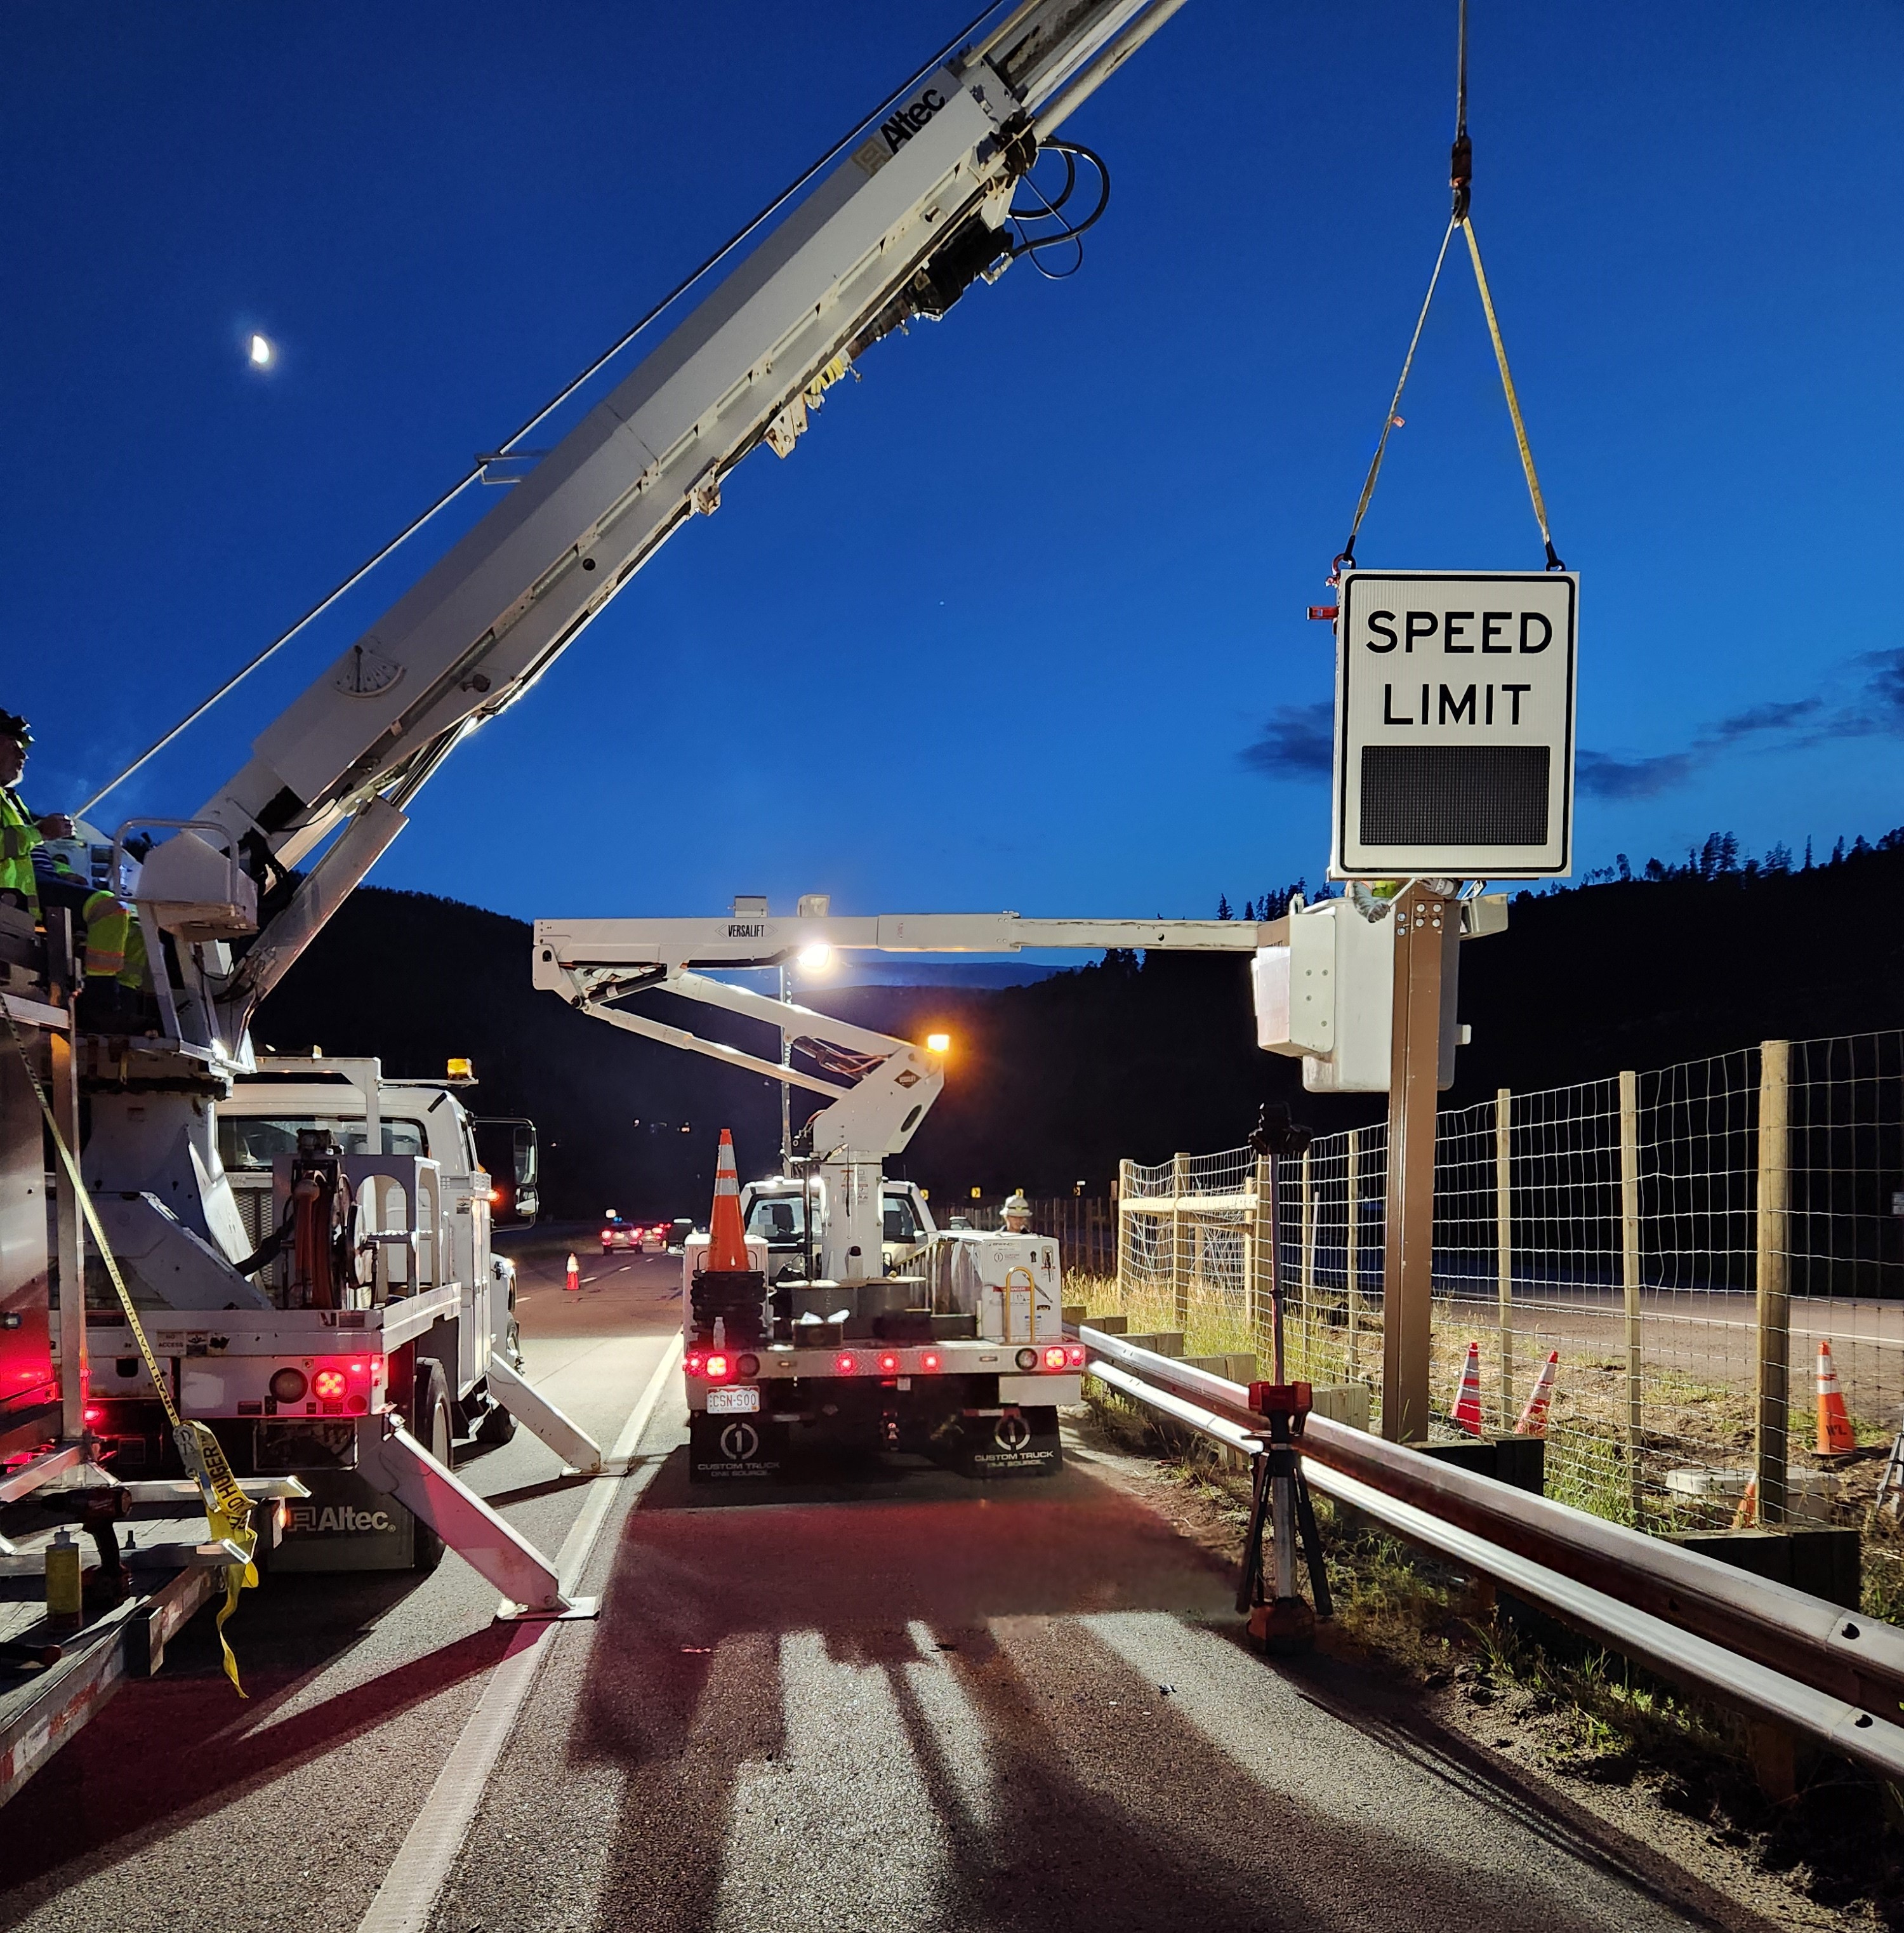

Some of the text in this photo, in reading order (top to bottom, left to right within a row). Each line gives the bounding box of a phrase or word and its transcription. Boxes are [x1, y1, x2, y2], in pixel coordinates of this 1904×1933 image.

[880, 89, 945, 154] Altec
[1366, 610, 1552, 654] SPEED
[1384, 684, 1531, 725] LIMIT
[728, 924, 765, 938] VERSALIFT
[975, 1451, 1054, 1461] CUSTOM TRUCK
